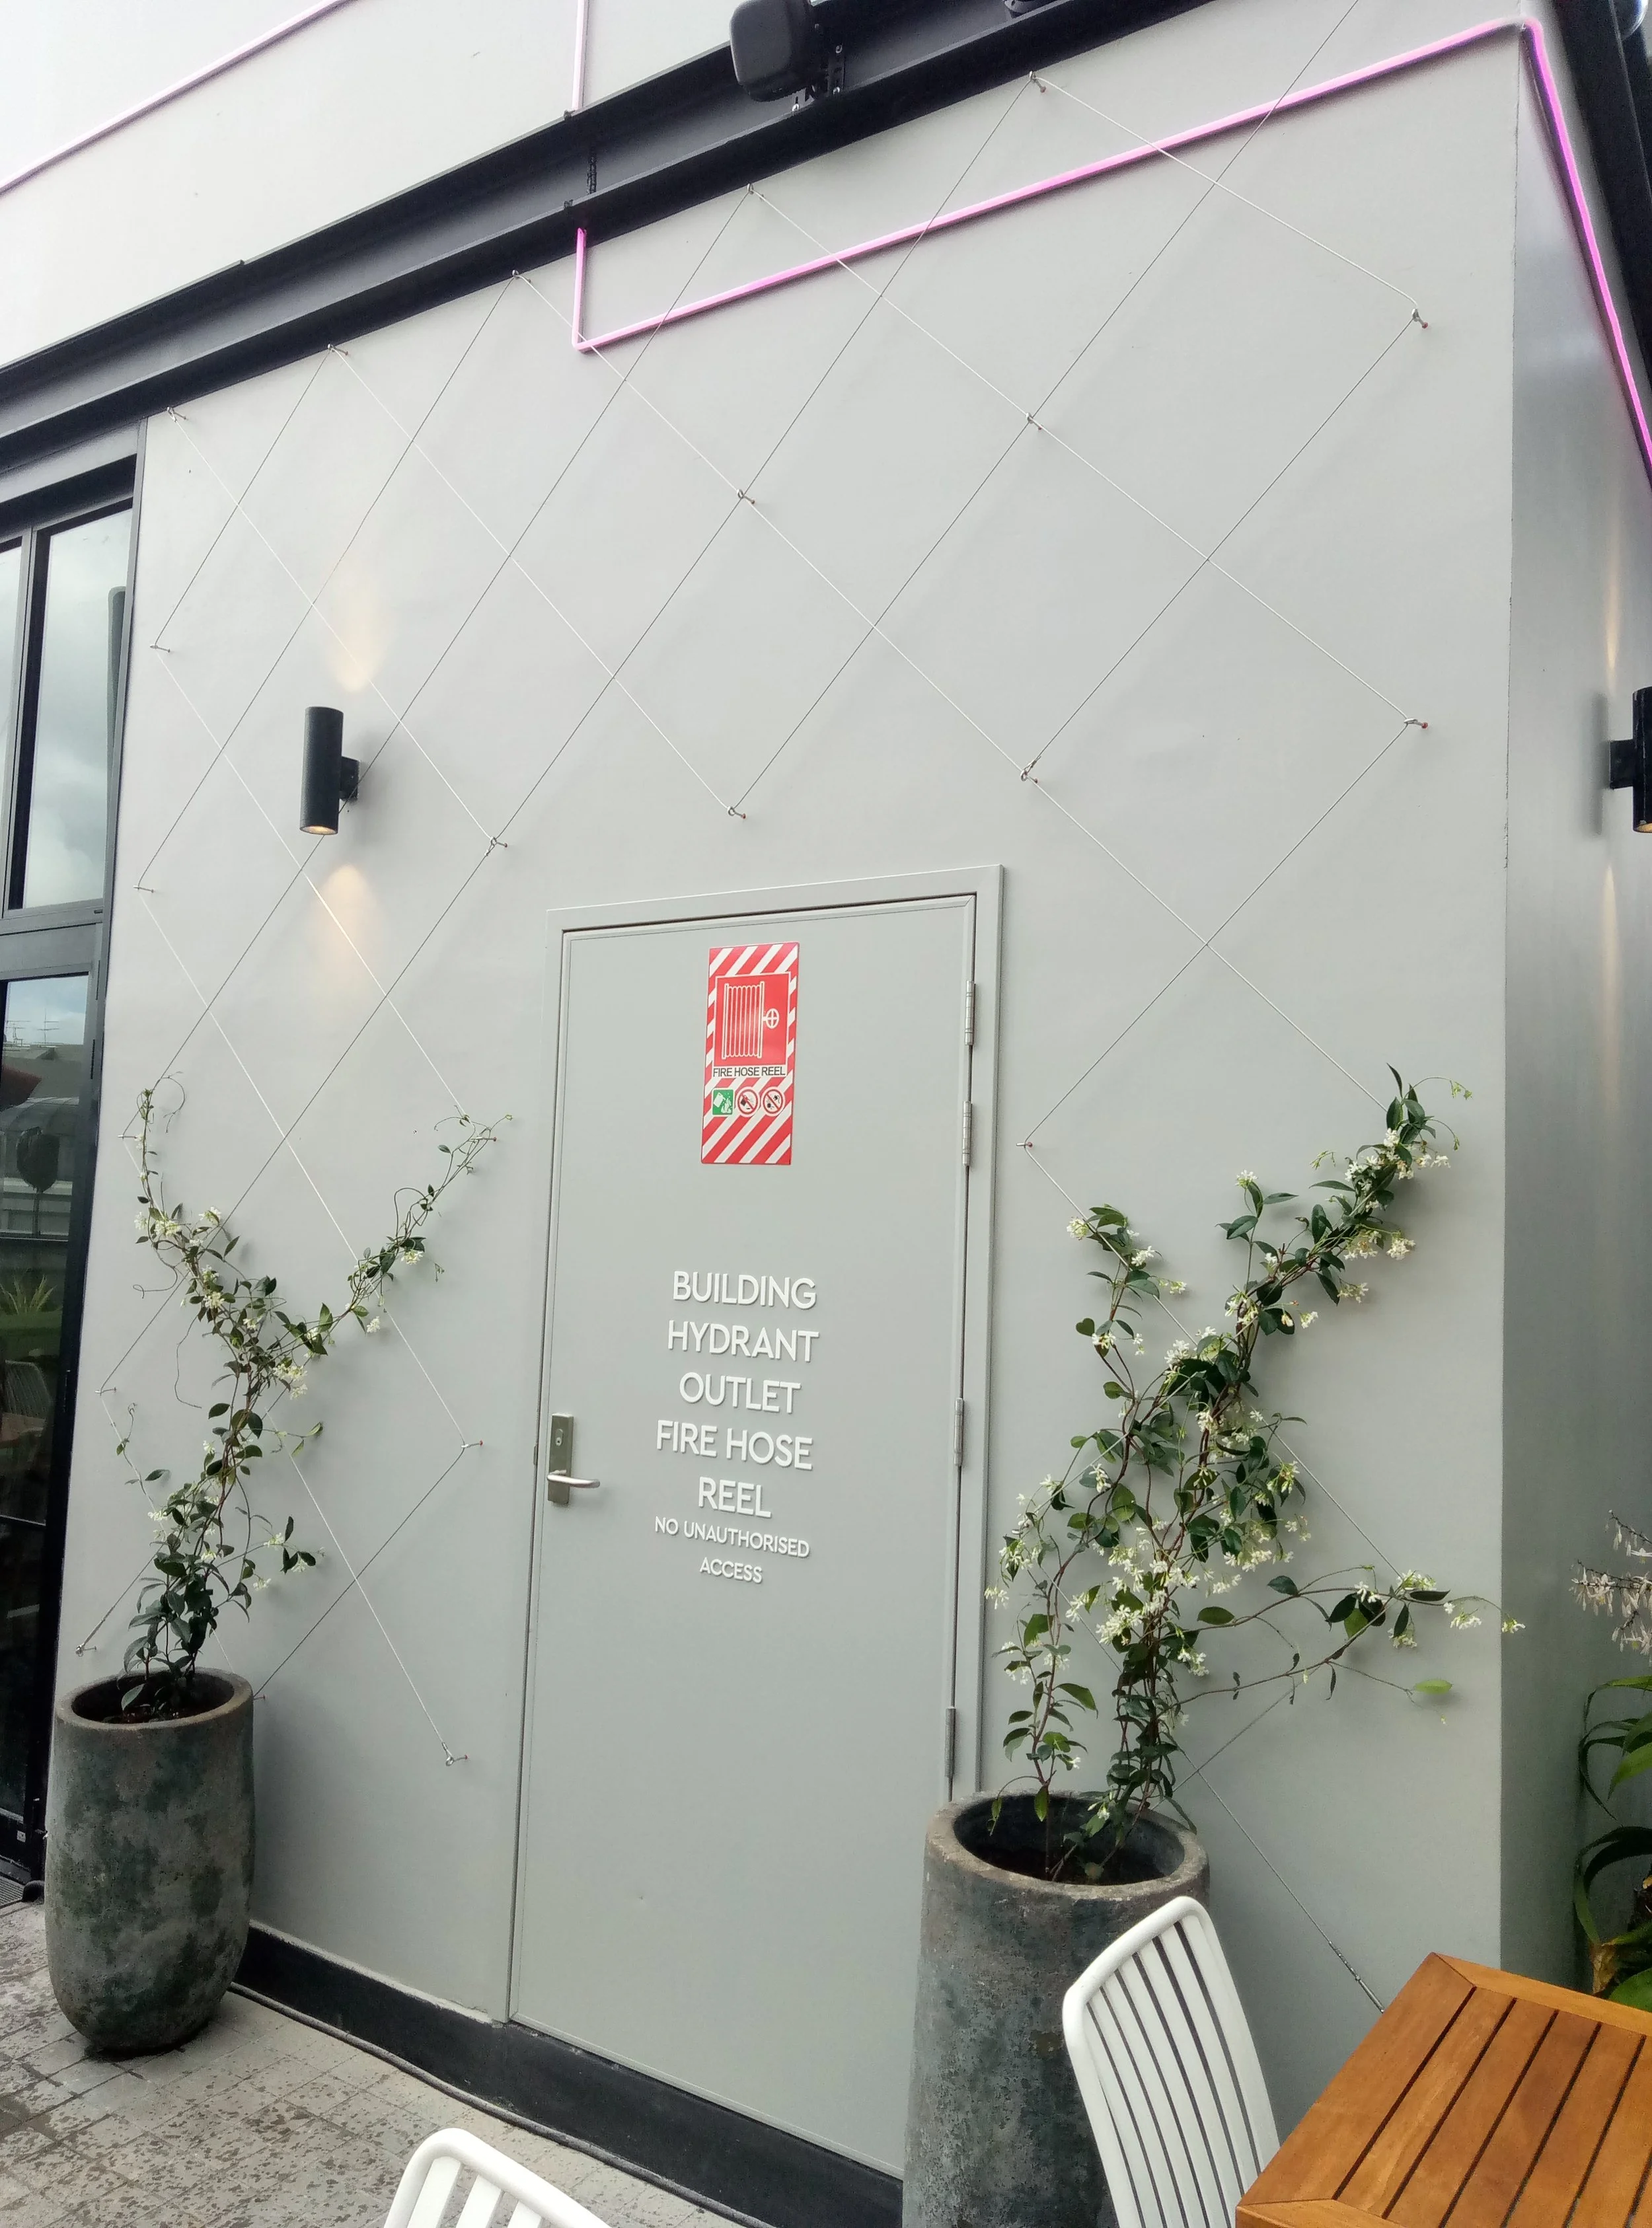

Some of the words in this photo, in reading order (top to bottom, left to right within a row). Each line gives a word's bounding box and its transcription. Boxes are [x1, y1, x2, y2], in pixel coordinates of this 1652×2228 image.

[713, 1067, 733, 1077] FIRE
[734, 1066, 759, 1076] HOSE
[761, 1066, 786, 1076] REEL
[673, 1271, 817, 1310] BUILDING
[667, 1319, 819, 1362] HYDRANT
[679, 1372, 802, 1413] OUTLET
[656, 1419, 718, 1457] FIRE
[726, 1427, 813, 1470] HOSE
[698, 1476, 772, 1518] REEL
[655, 1516, 679, 1535] NO
[683, 1520, 809, 1557] UNAUTHORISED
[699, 1557, 763, 1583] ACCESS
